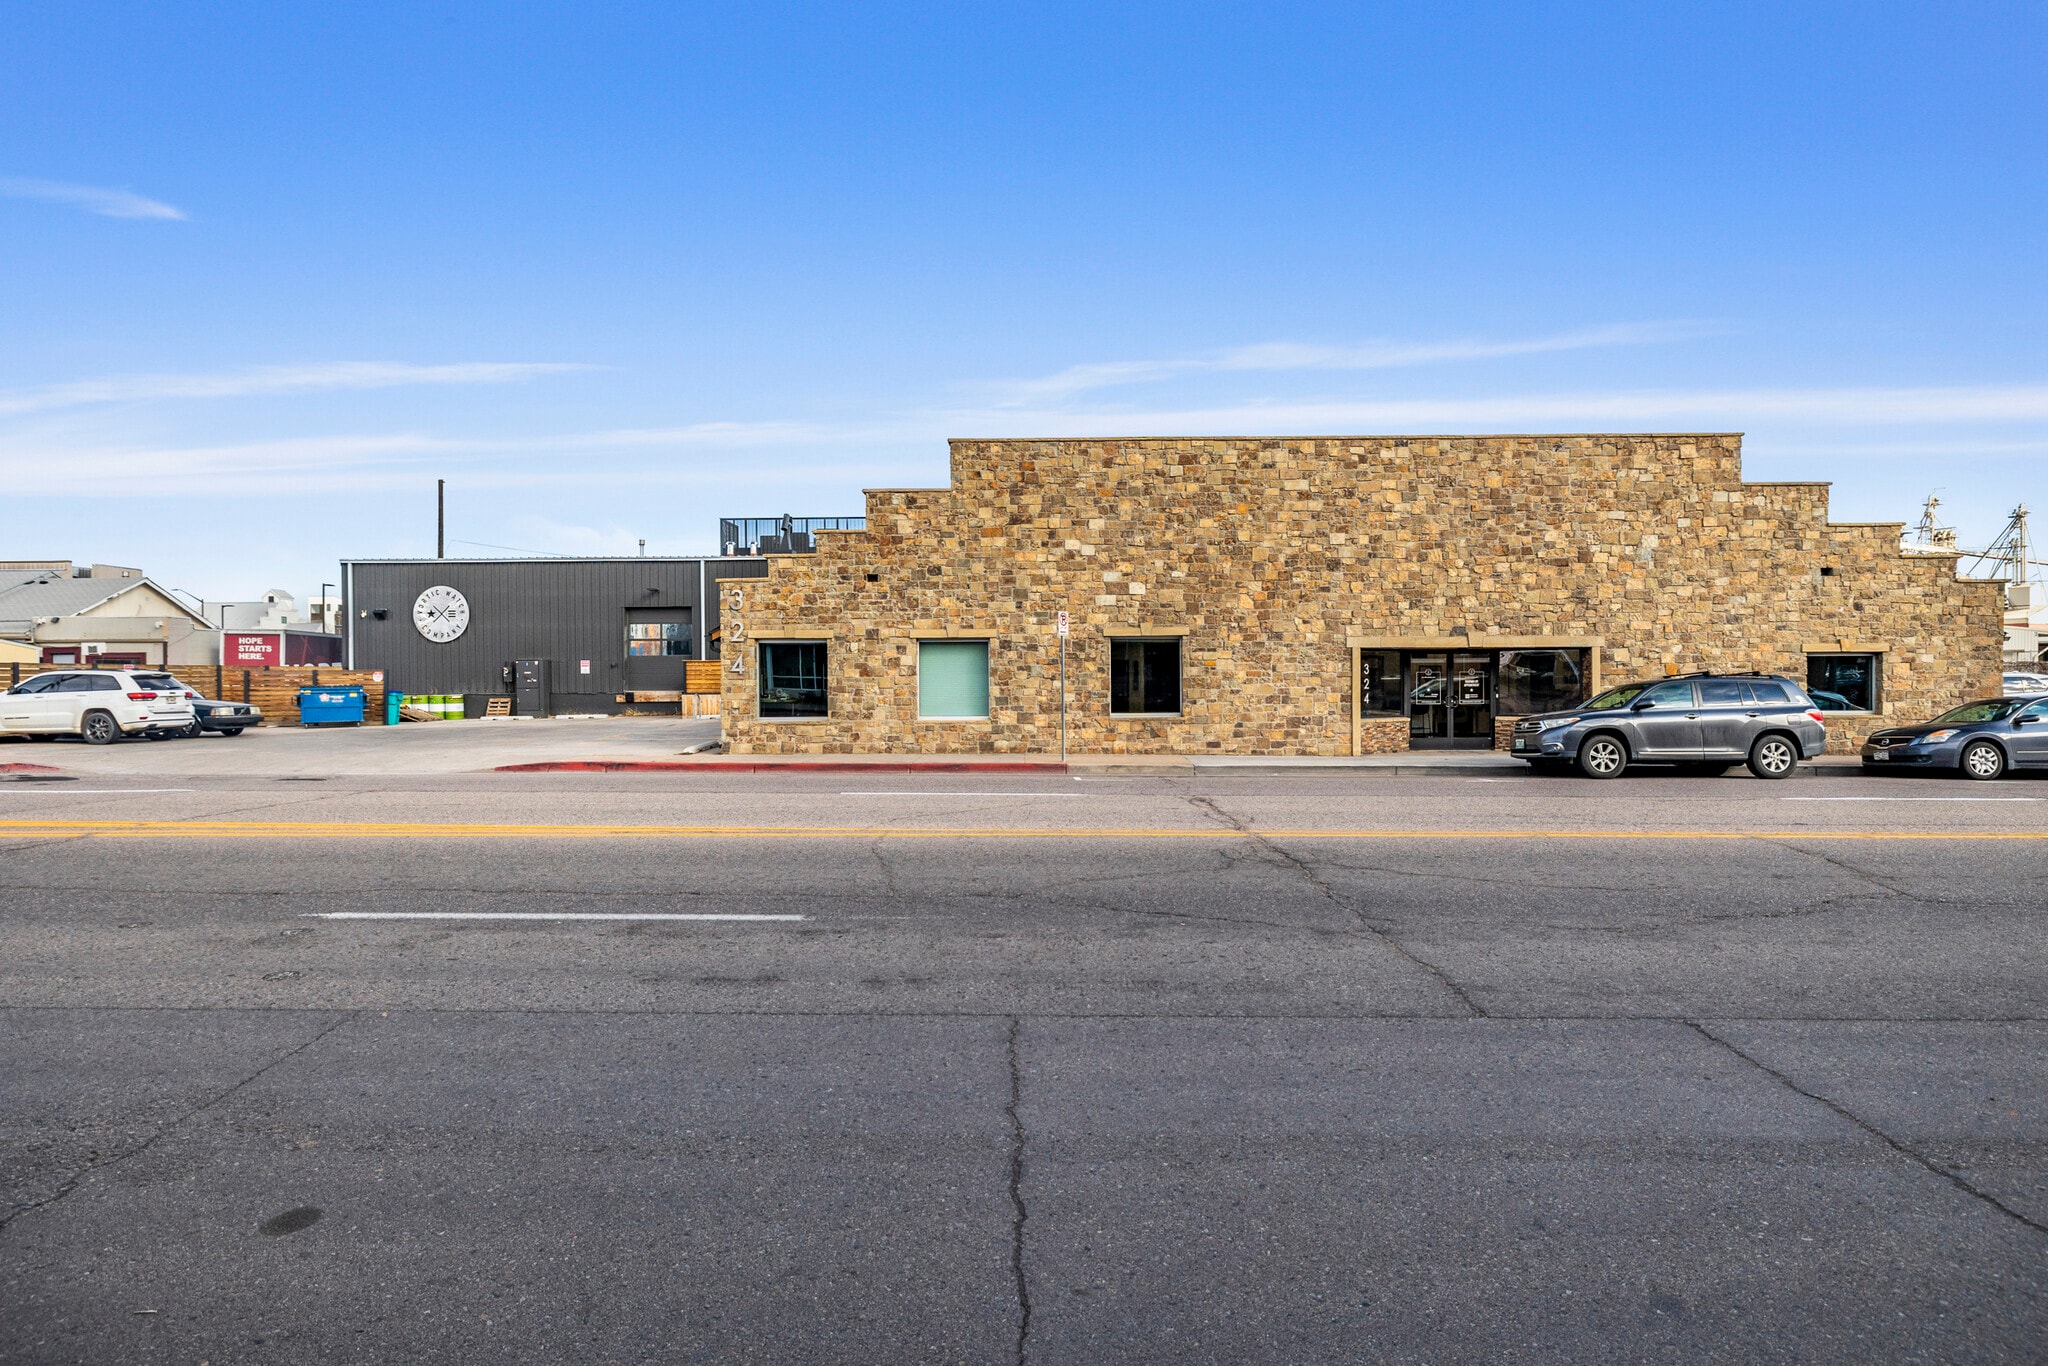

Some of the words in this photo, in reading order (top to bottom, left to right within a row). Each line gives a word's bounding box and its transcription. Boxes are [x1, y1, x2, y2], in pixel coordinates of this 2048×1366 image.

[417, 589, 440, 615] VORTIC
[445, 590, 465, 614] WATCH
[421, 624, 462, 639] COMPANY
[238, 637, 264, 645] HOPE
[238, 645, 273, 653] STARTS
[238, 652, 265, 660] HERE.
